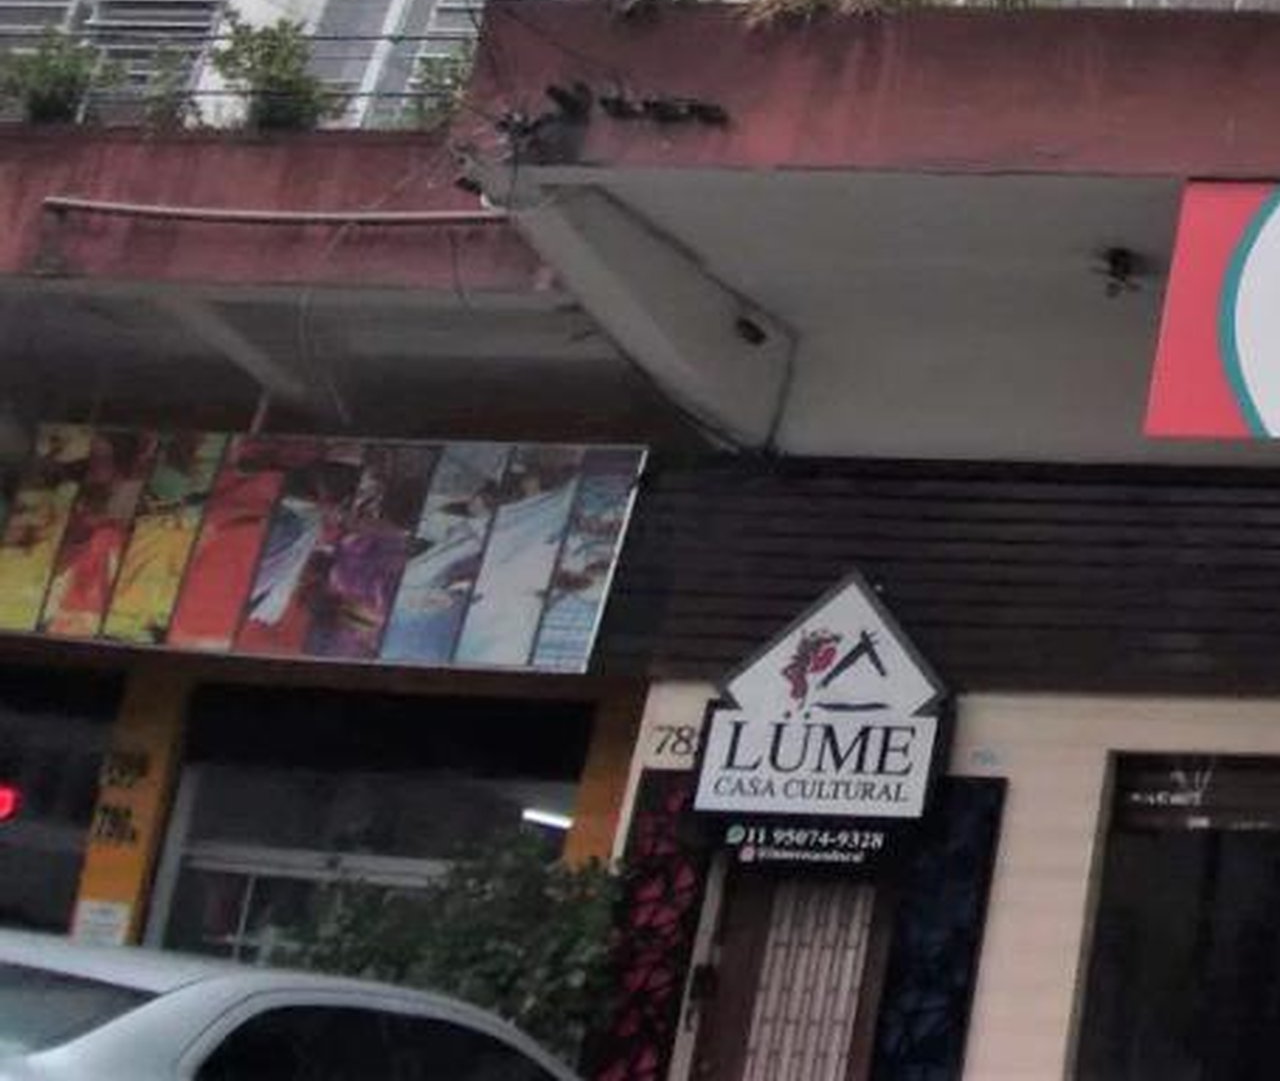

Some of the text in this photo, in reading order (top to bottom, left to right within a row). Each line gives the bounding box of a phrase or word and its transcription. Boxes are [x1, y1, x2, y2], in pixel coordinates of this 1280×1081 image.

[654, 725, 699, 756] 78
[714, 778, 909, 803] CASA CULTURAL
[746, 827, 766, 844] 11
